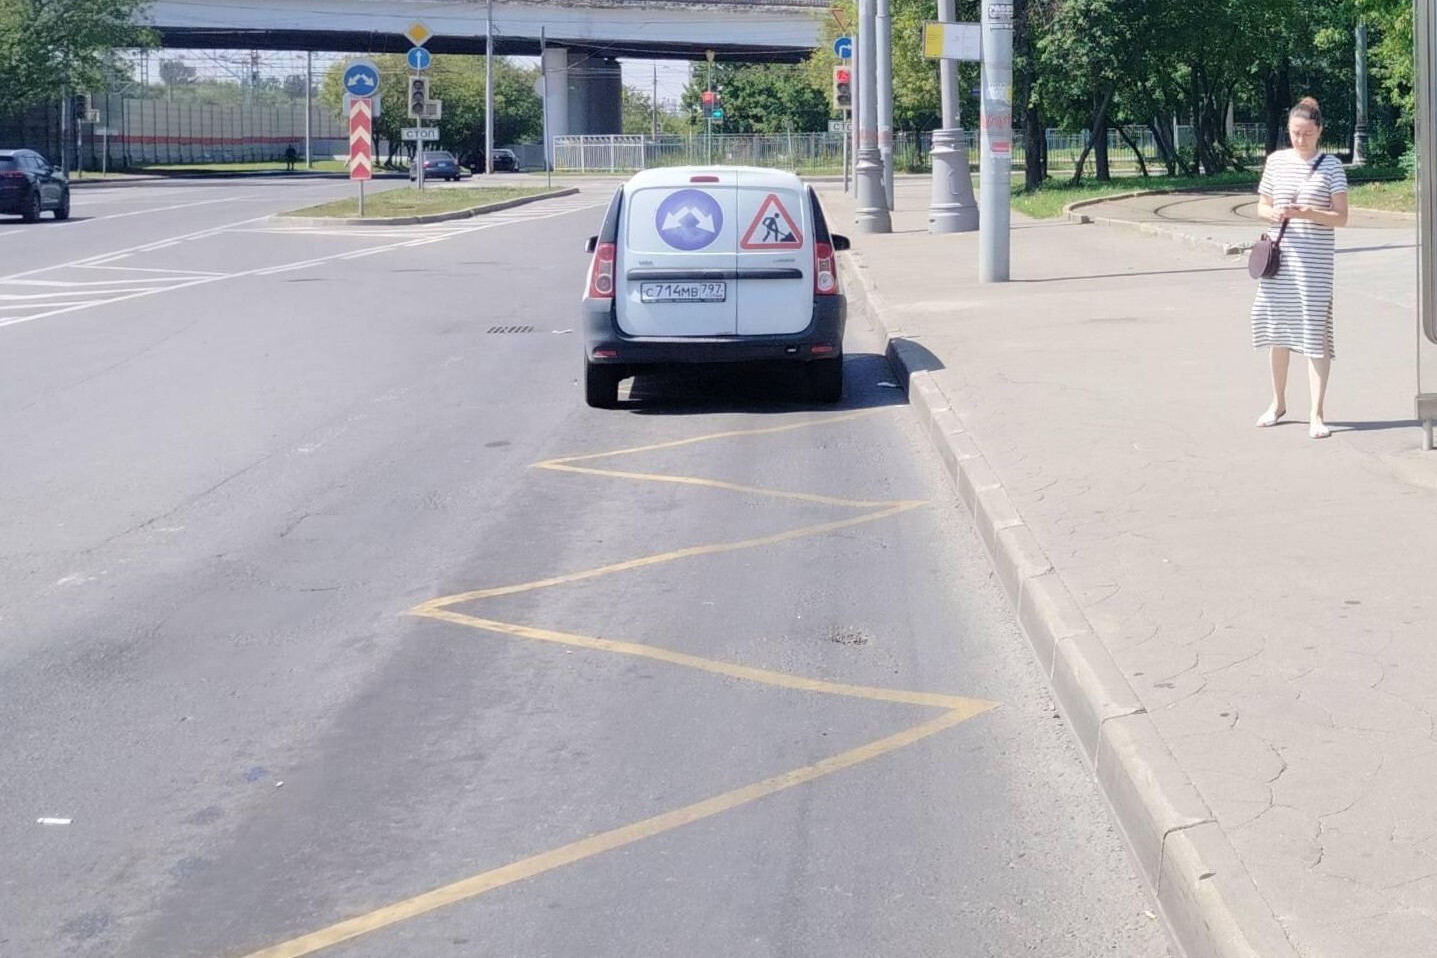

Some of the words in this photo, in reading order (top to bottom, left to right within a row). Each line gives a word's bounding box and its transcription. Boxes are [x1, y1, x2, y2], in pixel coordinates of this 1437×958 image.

[833, 123, 853, 131] СТО
[406, 130, 435, 138] СТОП
[701, 284, 721, 294] 797
